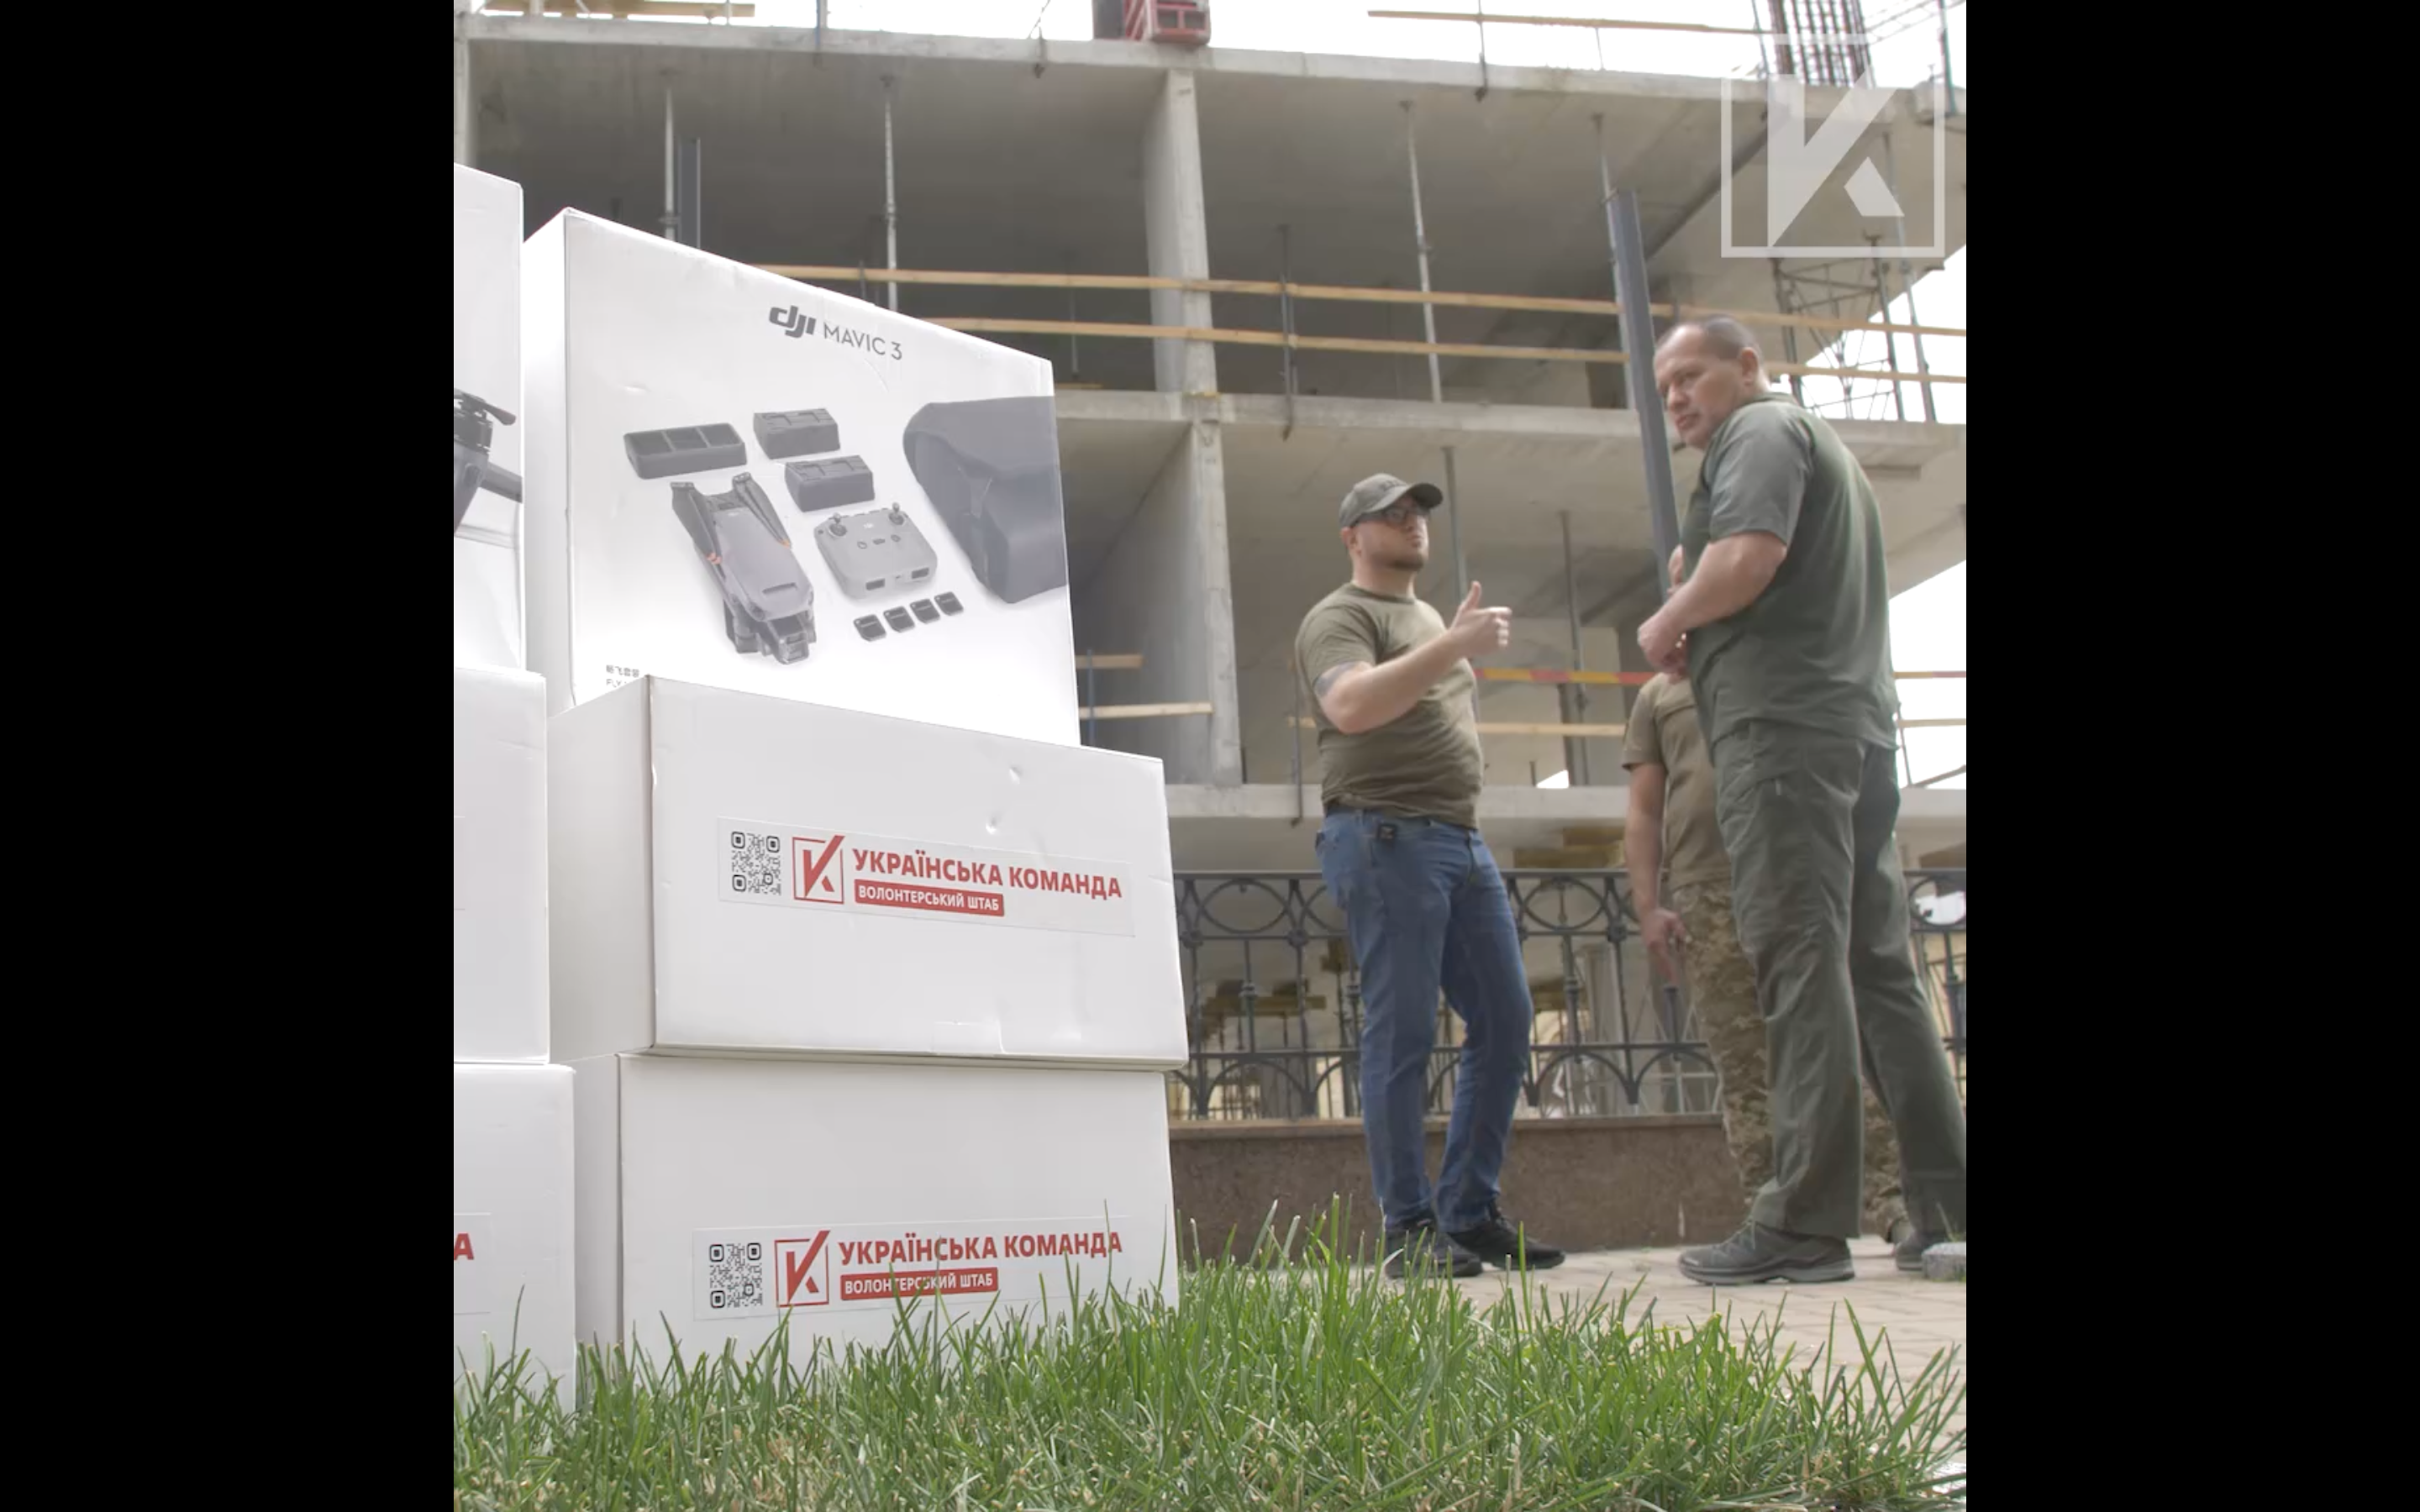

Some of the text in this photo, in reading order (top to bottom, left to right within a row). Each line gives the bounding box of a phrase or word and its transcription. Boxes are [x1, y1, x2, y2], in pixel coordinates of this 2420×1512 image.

[823, 321, 886, 355] MAVIC
[891, 341, 902, 360] 3
[852, 848, 1122, 900] УКРАЇНСЬКА КОМАНДА
[858, 885, 999, 911] ВОЛОНТЕРСЬКИЙ ШТАБ
[839, 1231, 1122, 1266] УКРАЇНСЬКА КОМАНДА
[960, 1273, 993, 1288] ШТАБ
